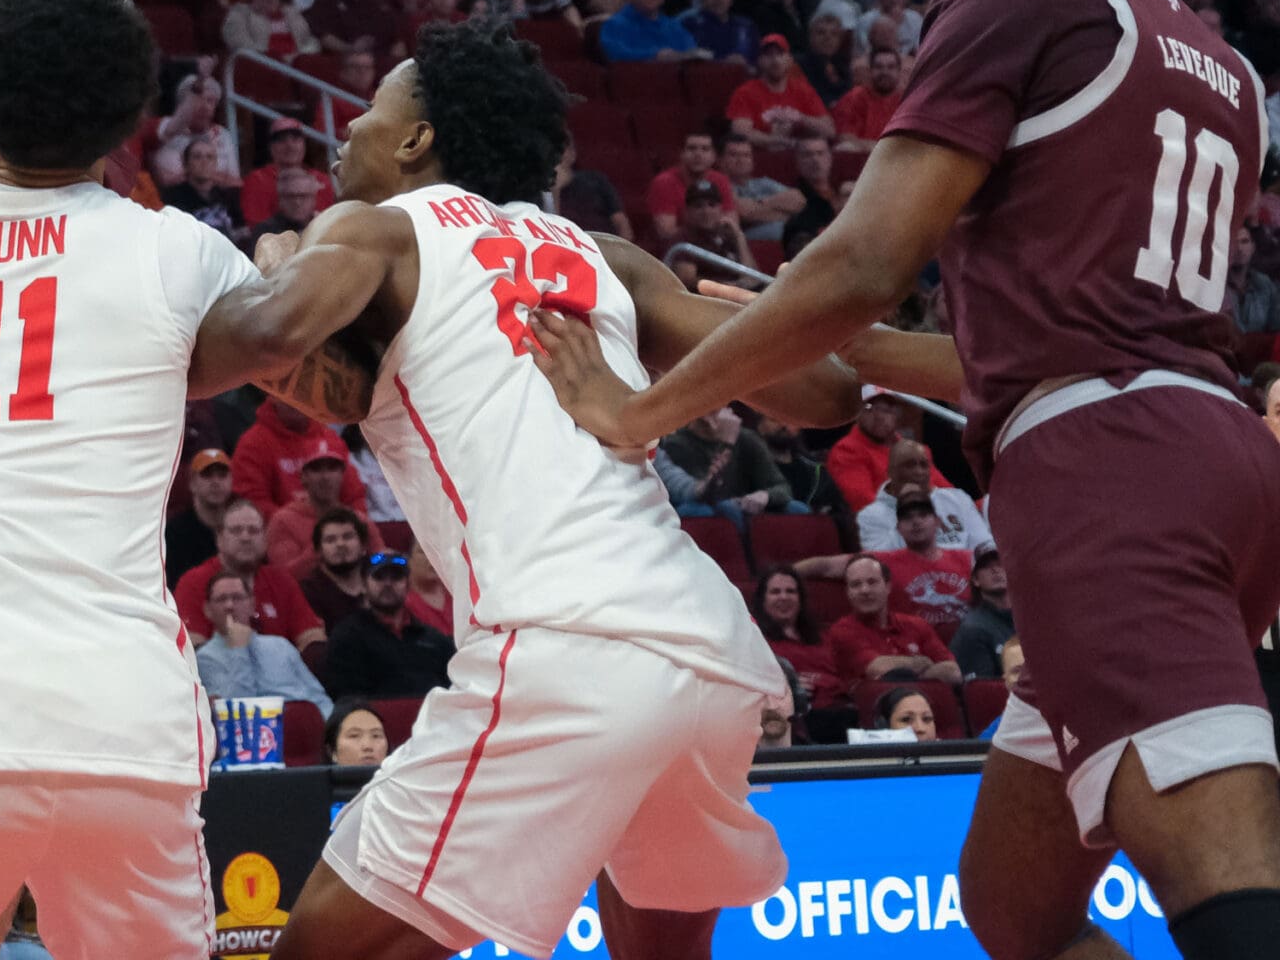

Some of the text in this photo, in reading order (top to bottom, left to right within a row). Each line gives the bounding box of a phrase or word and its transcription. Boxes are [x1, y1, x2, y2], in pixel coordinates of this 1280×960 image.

[1157, 34, 1241, 111] LEVEQUE
[1133, 108, 1240, 314] 10
[210, 928, 281, 953] HOWC
